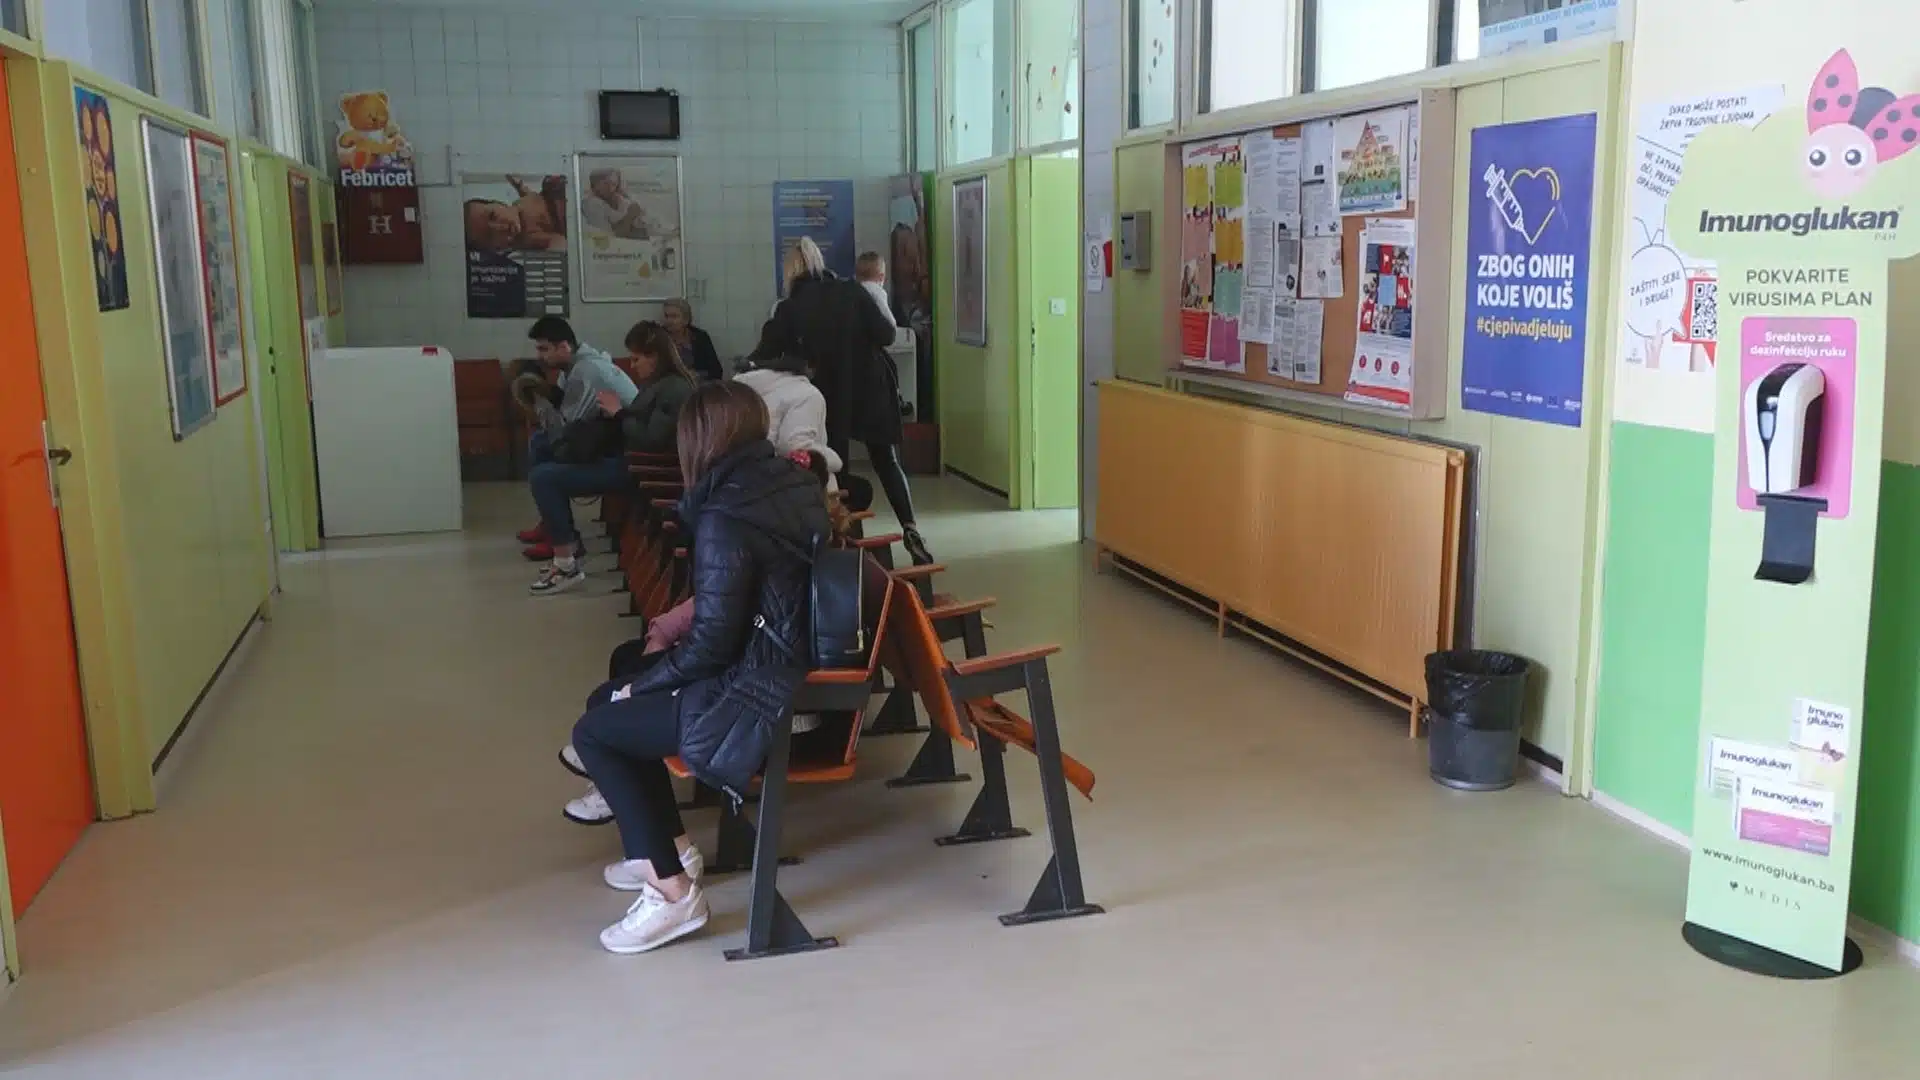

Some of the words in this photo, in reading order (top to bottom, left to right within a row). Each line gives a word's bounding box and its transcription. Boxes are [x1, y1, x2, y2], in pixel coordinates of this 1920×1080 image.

[340, 168, 414, 187] Febricet
[368, 214, 393, 235] H
[1699, 205, 1900, 237] Imunoglukan
[1477, 254, 1525, 278] ZBOG
[1528, 254, 1575, 279] ONIH
[1746, 268, 1850, 284] POKVARITE
[1477, 284, 1521, 309] KOJE
[1523, 282, 1574, 310] VOLIŠ
[1729, 291, 1817, 307] VIRUSIMA
[1821, 291, 1874, 307] PLAN
[1476, 315, 1573, 342] #cjepivadjeluju
[1764, 331, 1816, 344] Sredstvo
[1817, 333, 1832, 344] za
[1750, 345, 1818, 358] dezinfekciju
[1819, 346, 1847, 358] ruku
[1806, 716, 1844, 730] glukan
[1807, 704, 1844, 721] Imuno
[1719, 748, 1792, 772] Imunoglukan
[1751, 786, 1824, 809] Imunoglukan
[1702, 847, 1836, 894] www.imunoglukan.ba
